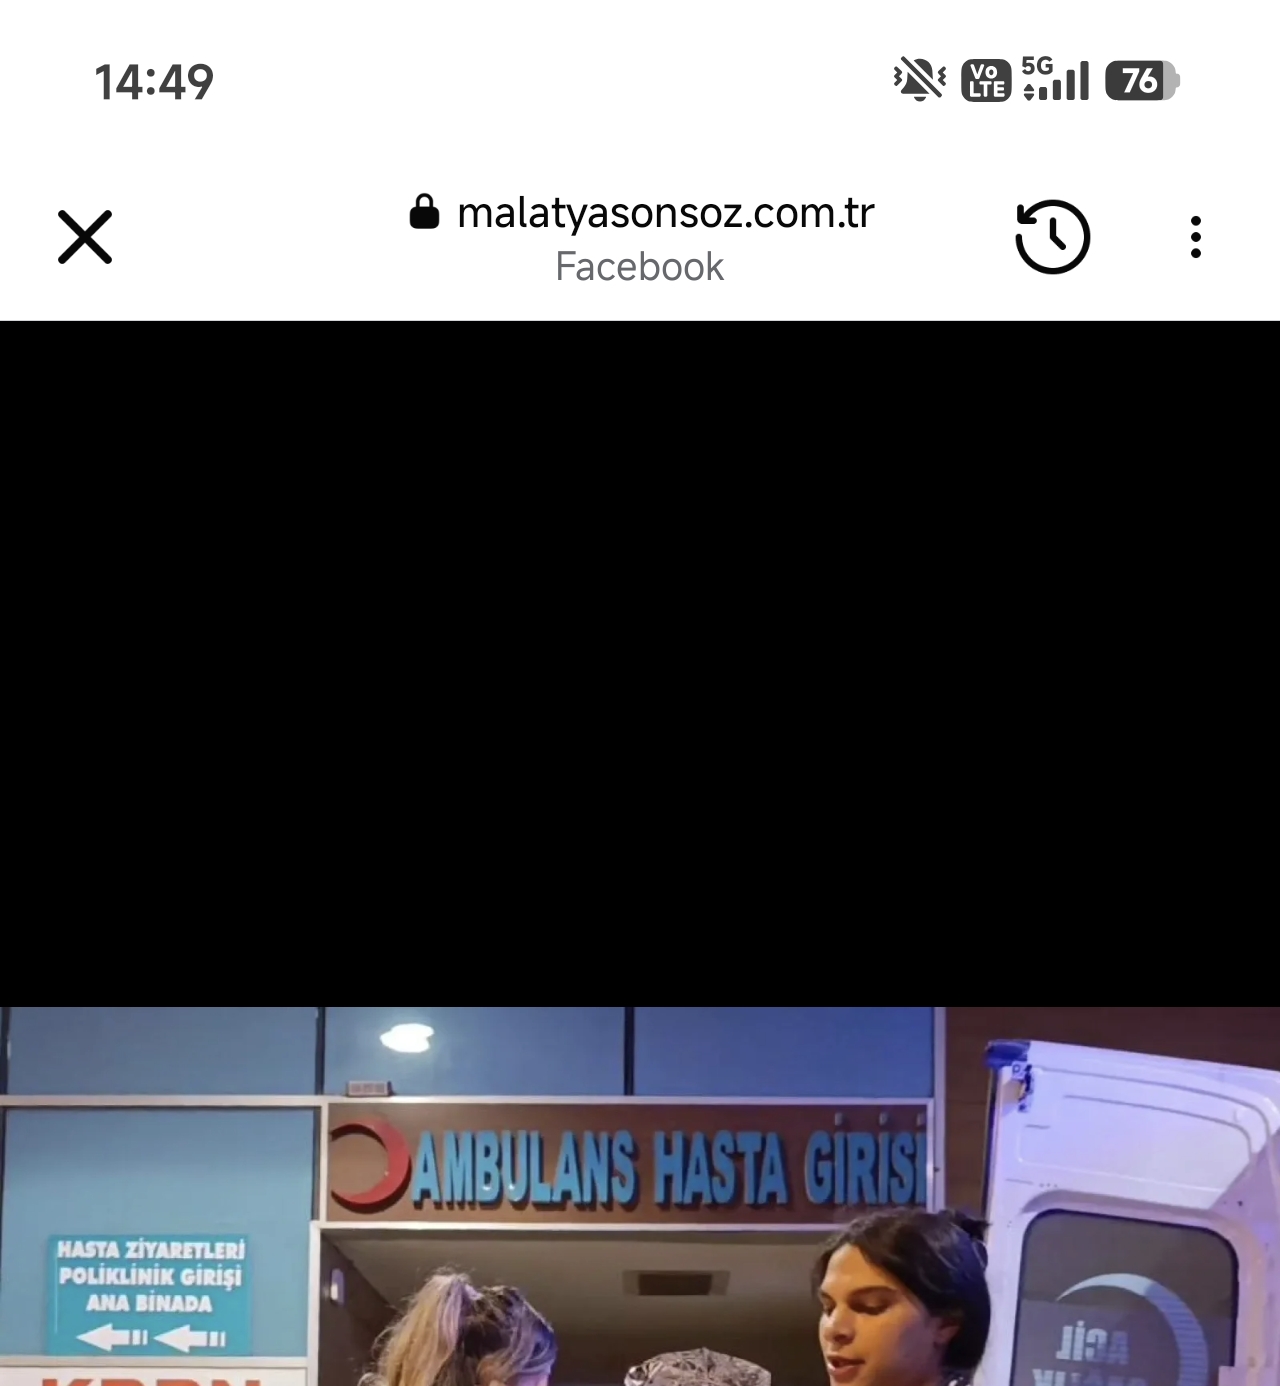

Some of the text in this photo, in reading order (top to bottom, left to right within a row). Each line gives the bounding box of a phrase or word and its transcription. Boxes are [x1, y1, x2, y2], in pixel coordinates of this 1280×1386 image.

[1022, 56, 1053, 75] 5G
[96, 64, 213, 99] 14:49
[970, 81, 1005, 97] LTE
[1123, 68, 1157, 93] 76
[460, 196, 875, 236] malatyasonsoz.com.tr
[558, 251, 724, 280] Facebook
[411, 1130, 638, 1207] AMBULANS
[653, 1130, 787, 1207] HASTA
[57, 1237, 245, 1261] HASTA ZİYARETLERİ
[59, 1263, 242, 1291] POLİKLİNİK GİRİŞİ
[86, 1289, 213, 1313] ANA BİNADA
